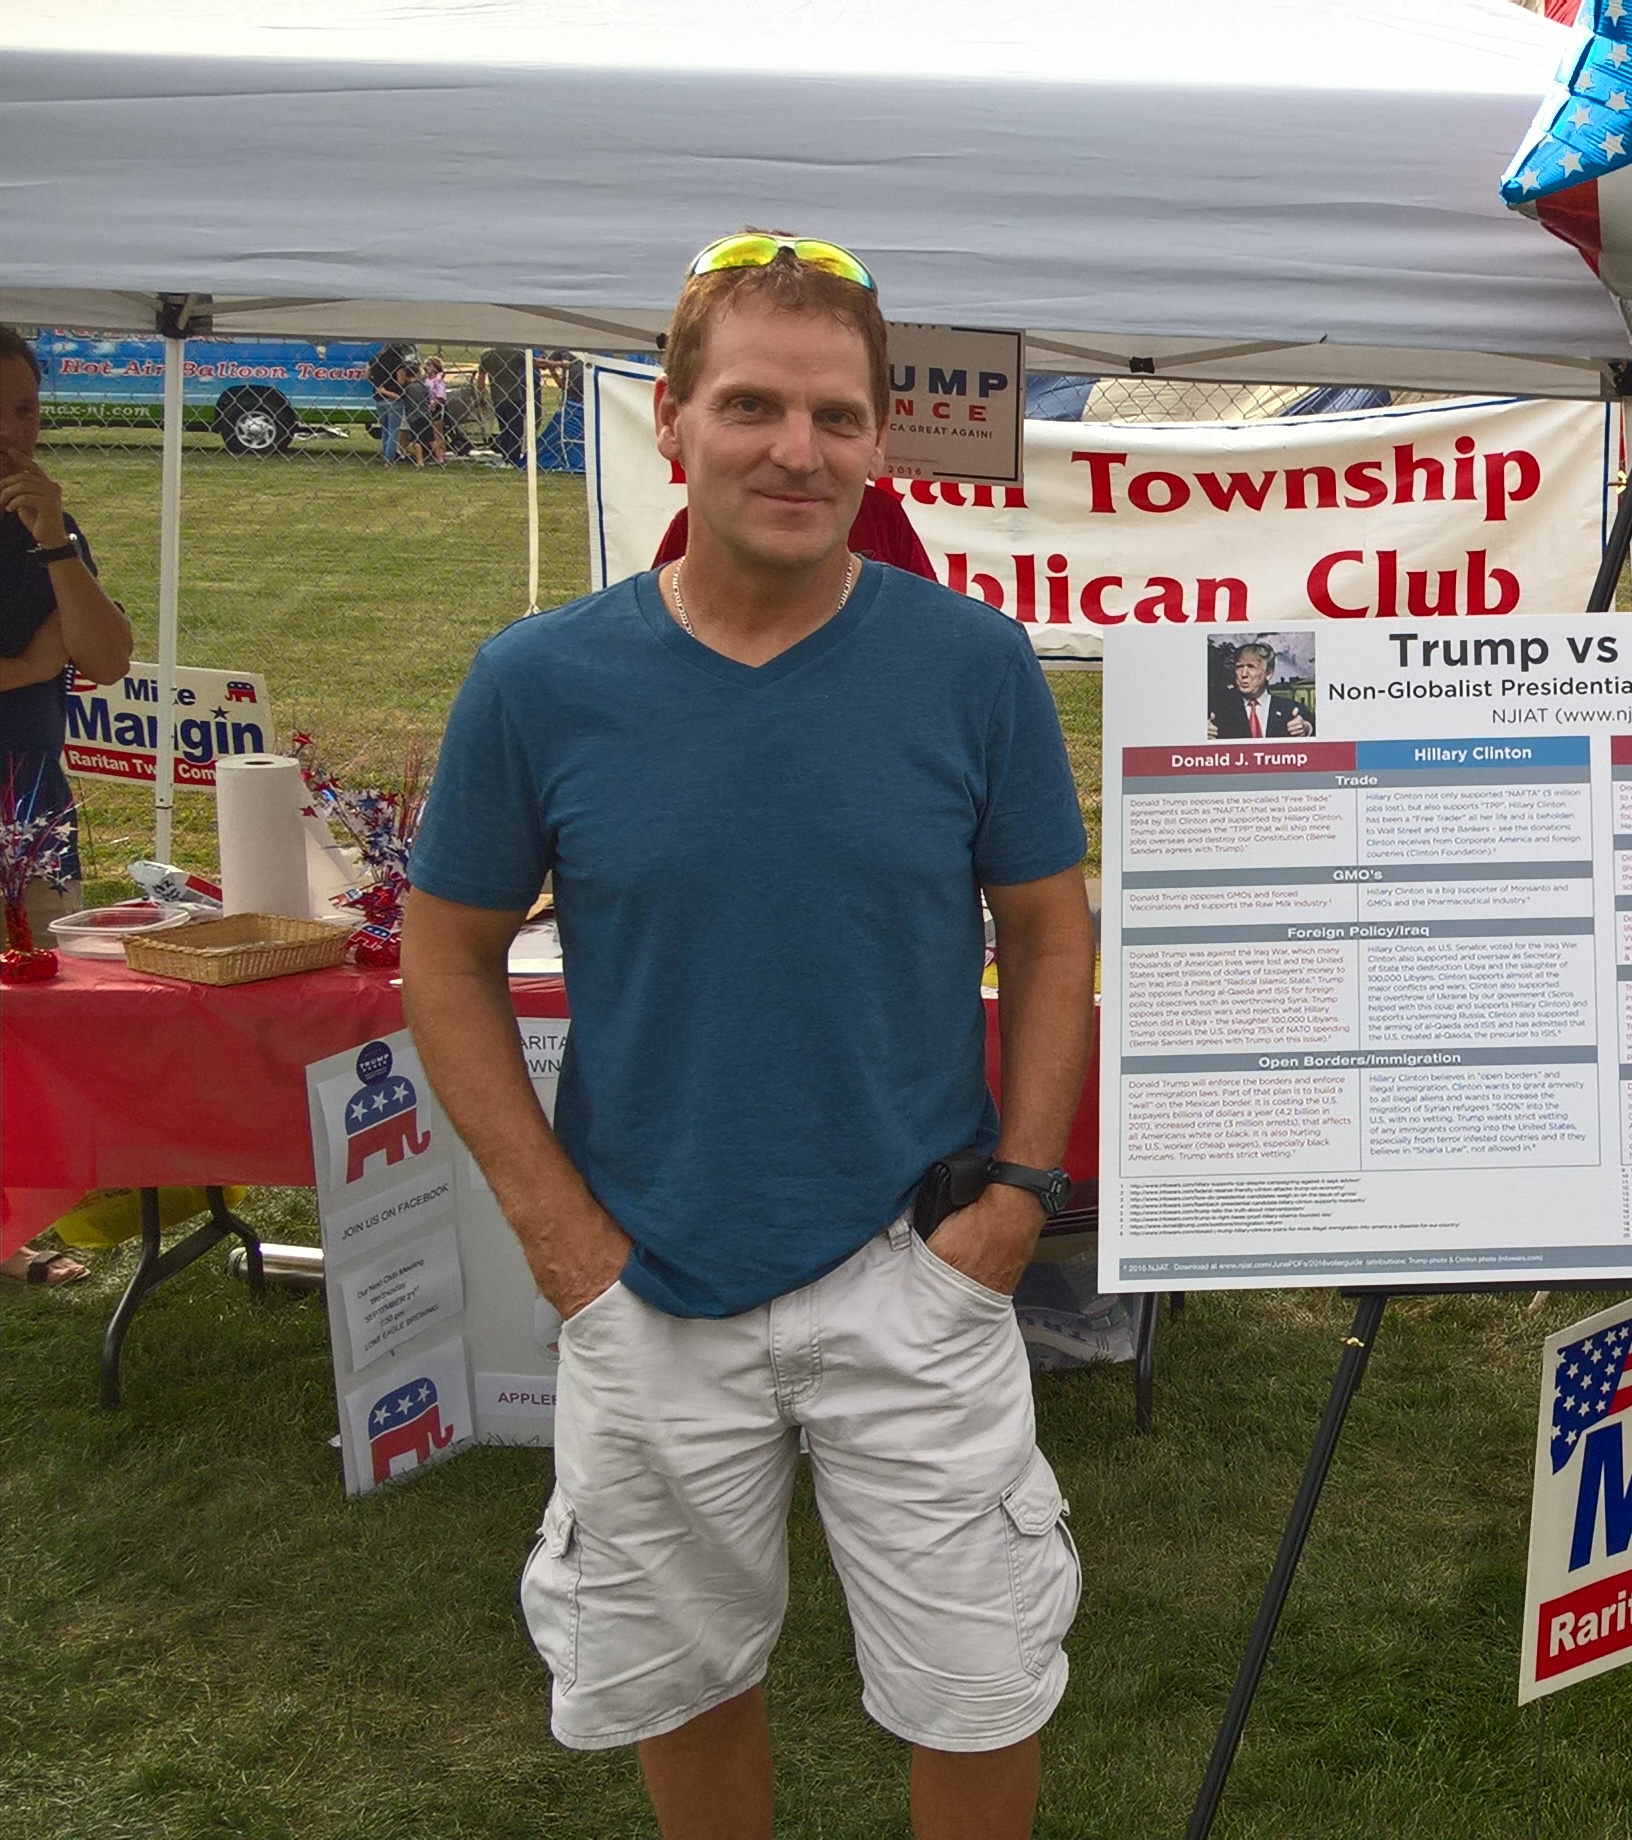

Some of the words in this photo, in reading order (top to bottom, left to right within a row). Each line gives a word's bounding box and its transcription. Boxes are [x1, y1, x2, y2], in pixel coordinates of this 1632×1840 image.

[61, 358, 110, 376] Hot
[123, 361, 166, 377] Air
[183, 361, 288, 379] Balloon
[297, 363, 369, 381] Team
[889, 364, 1008, 398] UMP
[895, 399, 987, 422] NCE
[910, 425, 948, 435] GREAT
[951, 428, 993, 439] AGAIN!
[888, 466, 922, 476] 2016
[1071, 435, 1541, 522] Township
[944, 553, 1250, 625] blican
[1306, 548, 1521, 619] Club
[1389, 633, 1549, 672] Trump
[1567, 636, 1618, 664] vs
[123, 676, 196, 706] Mie
[1328, 680, 1492, 700] Non-Globalist
[1492, 708, 1548, 724] NJIAT
[68, 750, 130, 772] Raritan
[1171, 753, 1230, 768] Donald
[1235, 753, 1248, 766] J.
[1254, 752, 1308, 768] Trump
[1414, 748, 1468, 763] Hillary
[1472, 747, 1532, 761] Clinton
[1335, 774, 1378, 786] Trade
[1333, 868, 1383, 881] GMO's
[1130, 893, 1159, 901] Donald
[1162, 893, 1188, 902] Trump
[1190, 894, 1225, 902] opposes
[1271, 890, 1298, 898] forced
[1367, 888, 1393, 896] Hillary
[1395, 887, 1424, 895] Clinton
[1442, 886, 1456, 895] big
[1458, 886, 1497, 895] supporter
[1499, 885, 1509, 893] of
[1511, 884, 1551, 892] Monsanto
[1412, 898, 1425, 906] the
[1427, 897, 1490, 906] Pharmaceutical
[1287, 927, 1344, 939] Foreign
[1349, 925, 1430, 939] Policy/Iraq
[1258, 1056, 1299, 1069] Open
[1303, 1053, 1461, 1068] Borders/Immigration
[342, 1221, 364, 1240] JOIN
[365, 1214, 379, 1228] US
[381, 1207, 396, 1221] ON
[397, 1183, 449, 1214] FACEBOOK
